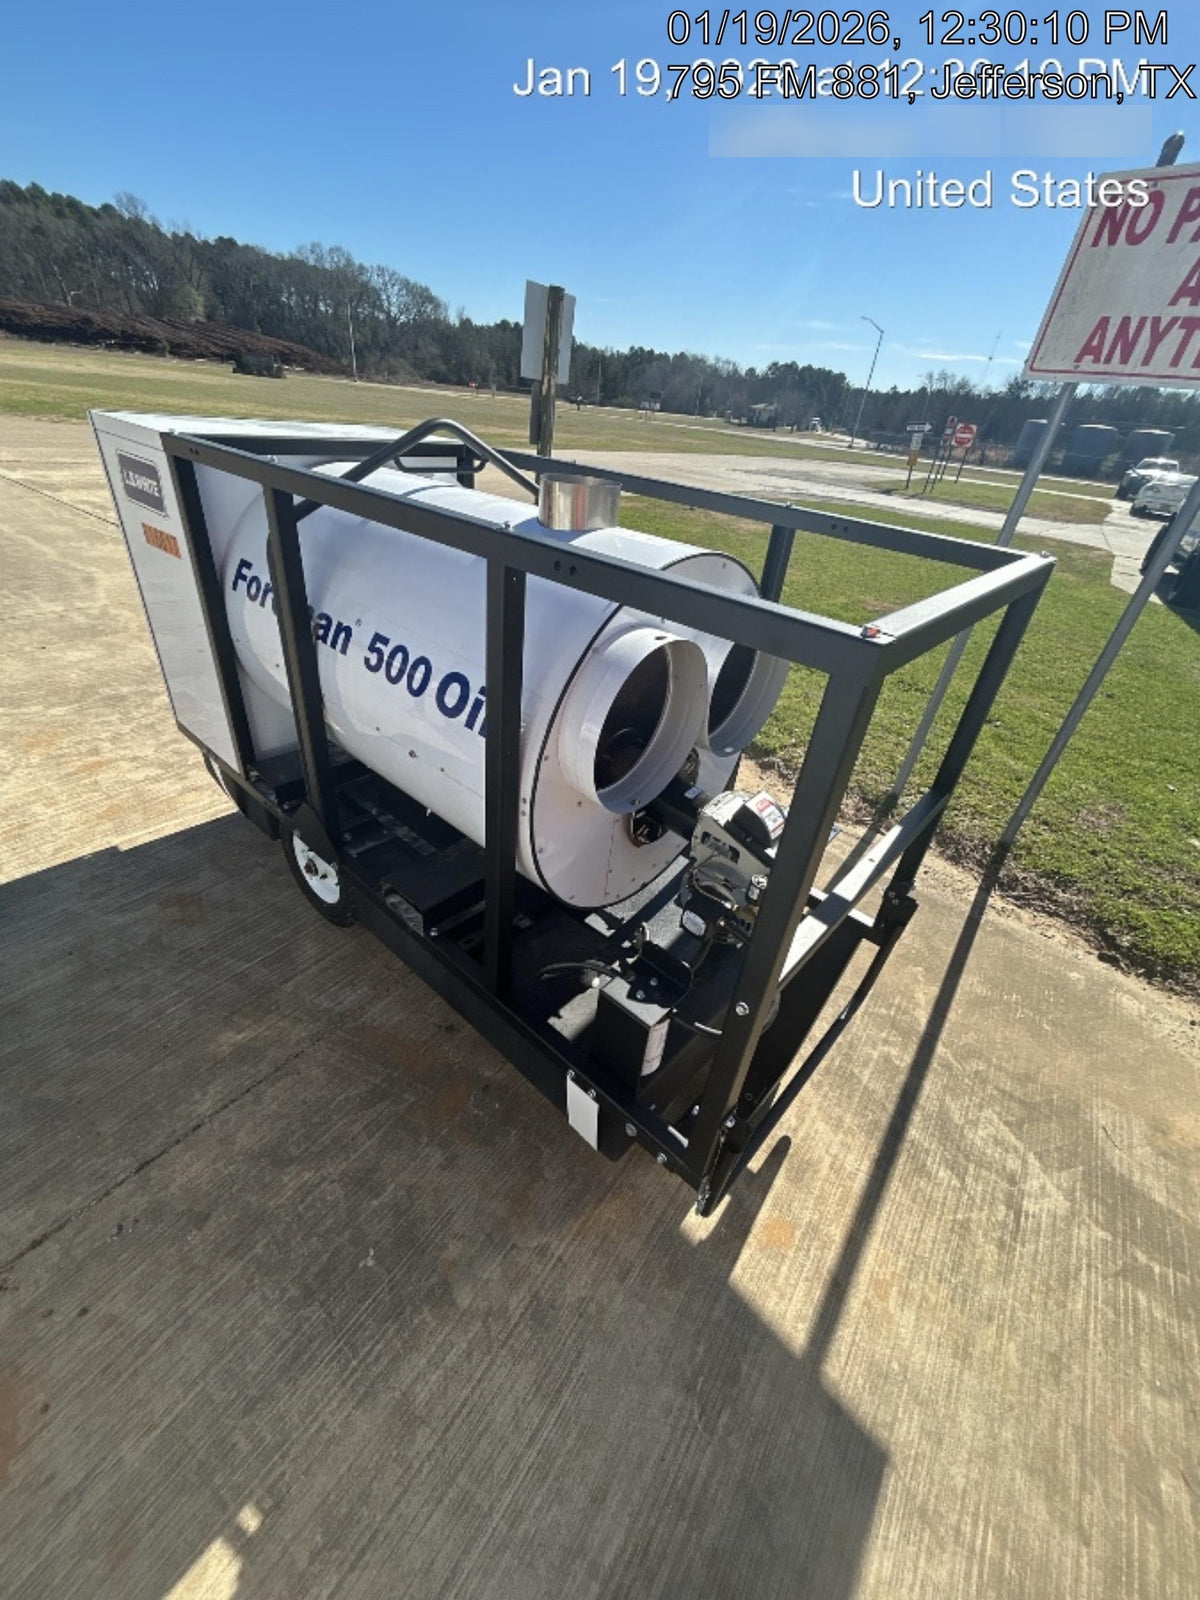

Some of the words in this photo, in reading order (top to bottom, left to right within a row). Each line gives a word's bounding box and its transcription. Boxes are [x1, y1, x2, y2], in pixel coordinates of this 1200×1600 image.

[1091, 189, 1166, 247] NO
[1074, 315, 1200, 369] ANYT
[232, 558, 352, 656] Foran
[364, 631, 432, 698] 500
